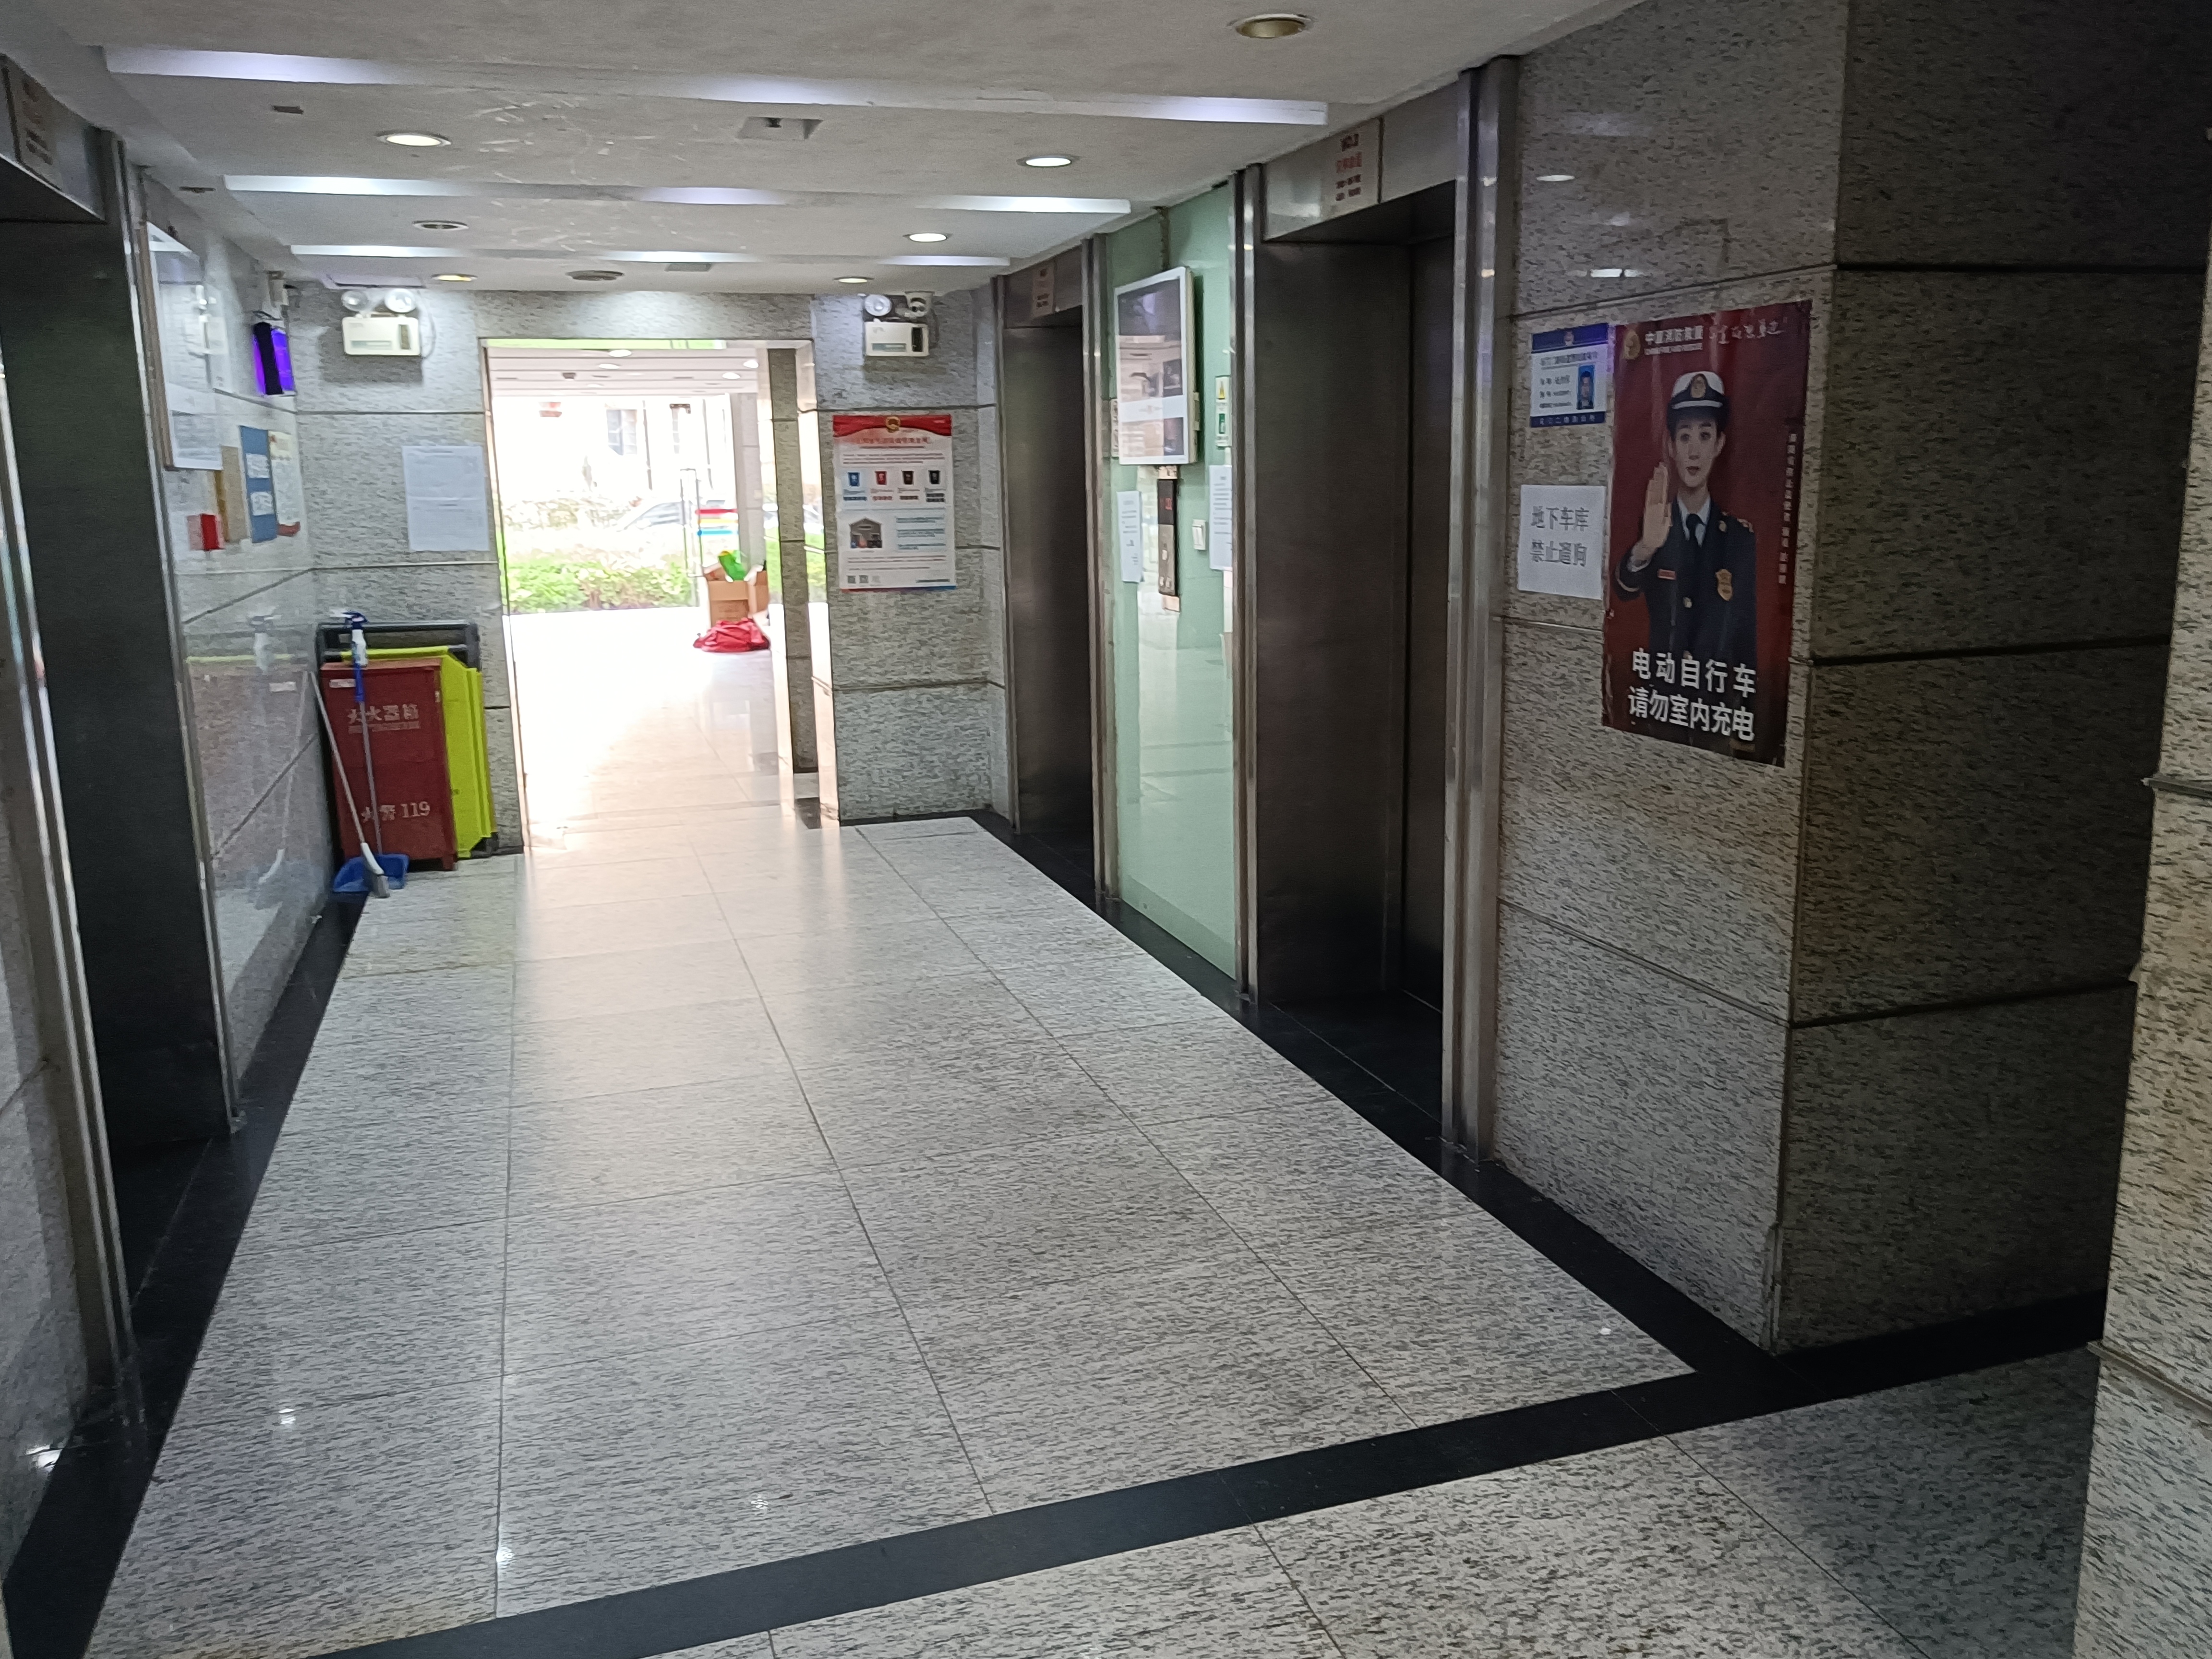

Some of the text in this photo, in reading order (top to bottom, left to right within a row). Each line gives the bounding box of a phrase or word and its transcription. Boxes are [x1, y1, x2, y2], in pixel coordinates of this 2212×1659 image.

[1530, 505, 1589, 532] 地下车库
[1631, 647, 1757, 698] 电动自行车
[1627, 685, 1755, 742] 请勿室内充电
[400, 801, 431, 818] 119
